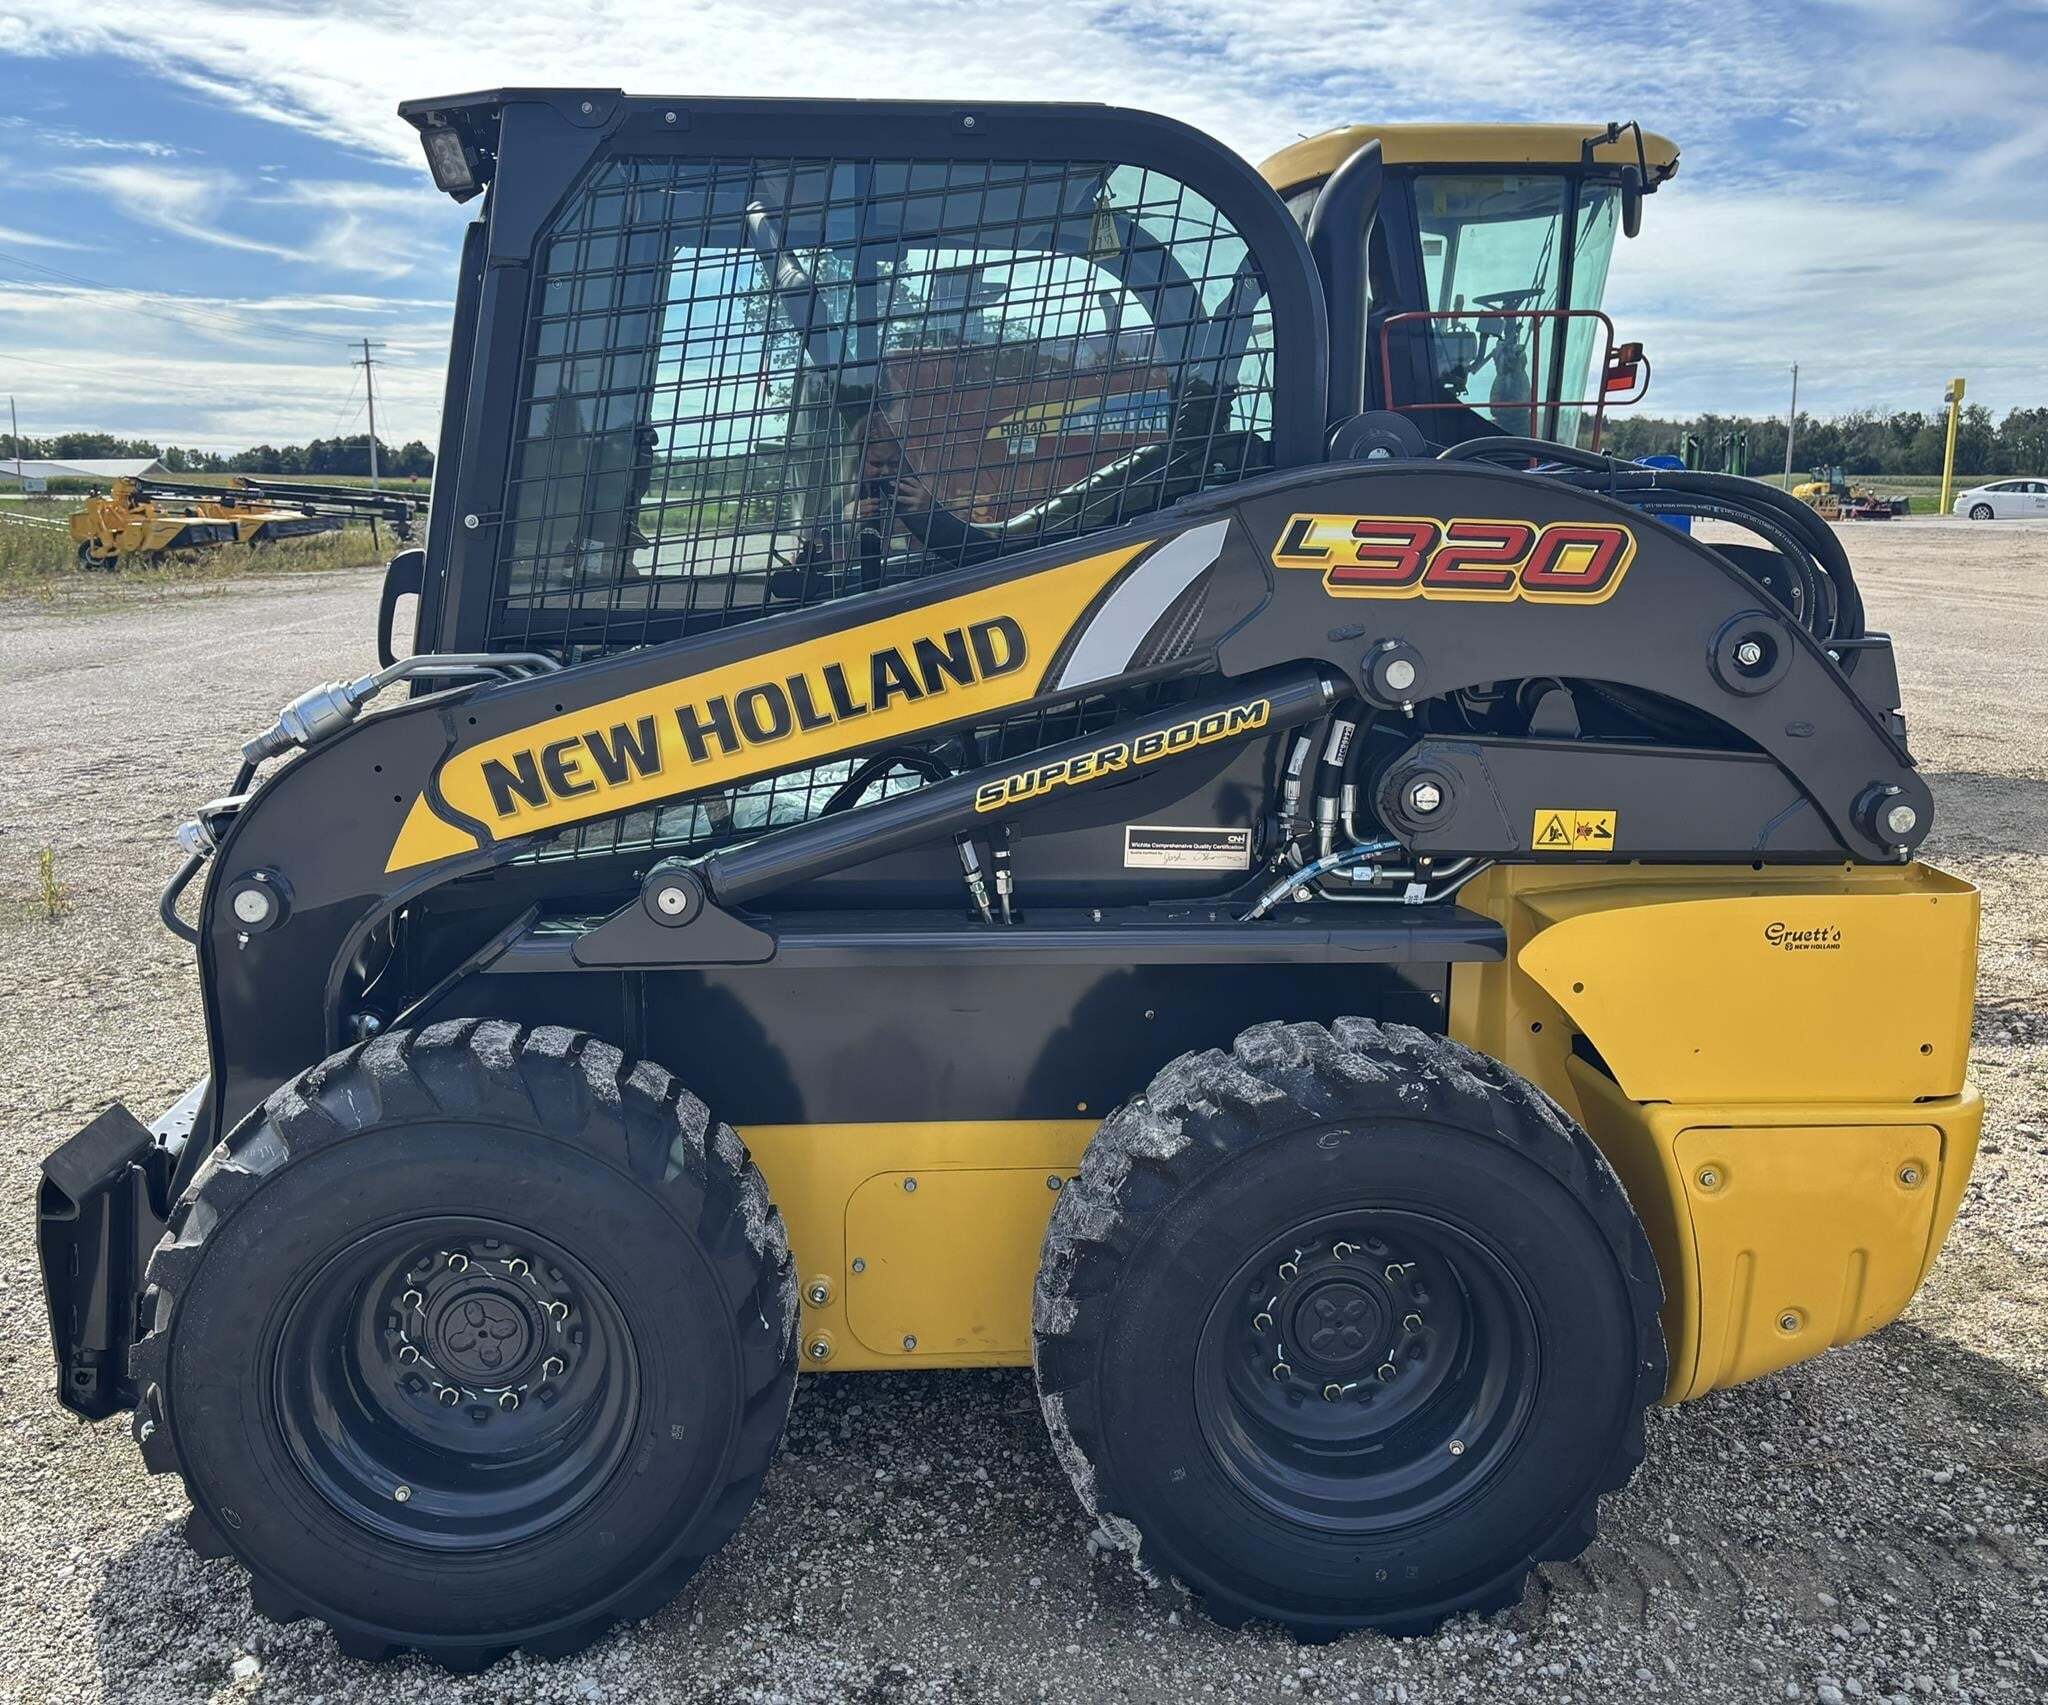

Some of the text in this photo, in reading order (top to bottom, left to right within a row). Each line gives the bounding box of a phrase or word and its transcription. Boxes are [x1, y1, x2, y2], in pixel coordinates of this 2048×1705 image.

[1272, 513, 1638, 604] L320
[480, 615, 1028, 817] NEW HOLLAND
[976, 742, 1129, 813] SUPER
[1132, 699, 1270, 764] BOOM
[1227, 833, 1246, 843] CNH
[1764, 922, 1841, 946] Gruett's
